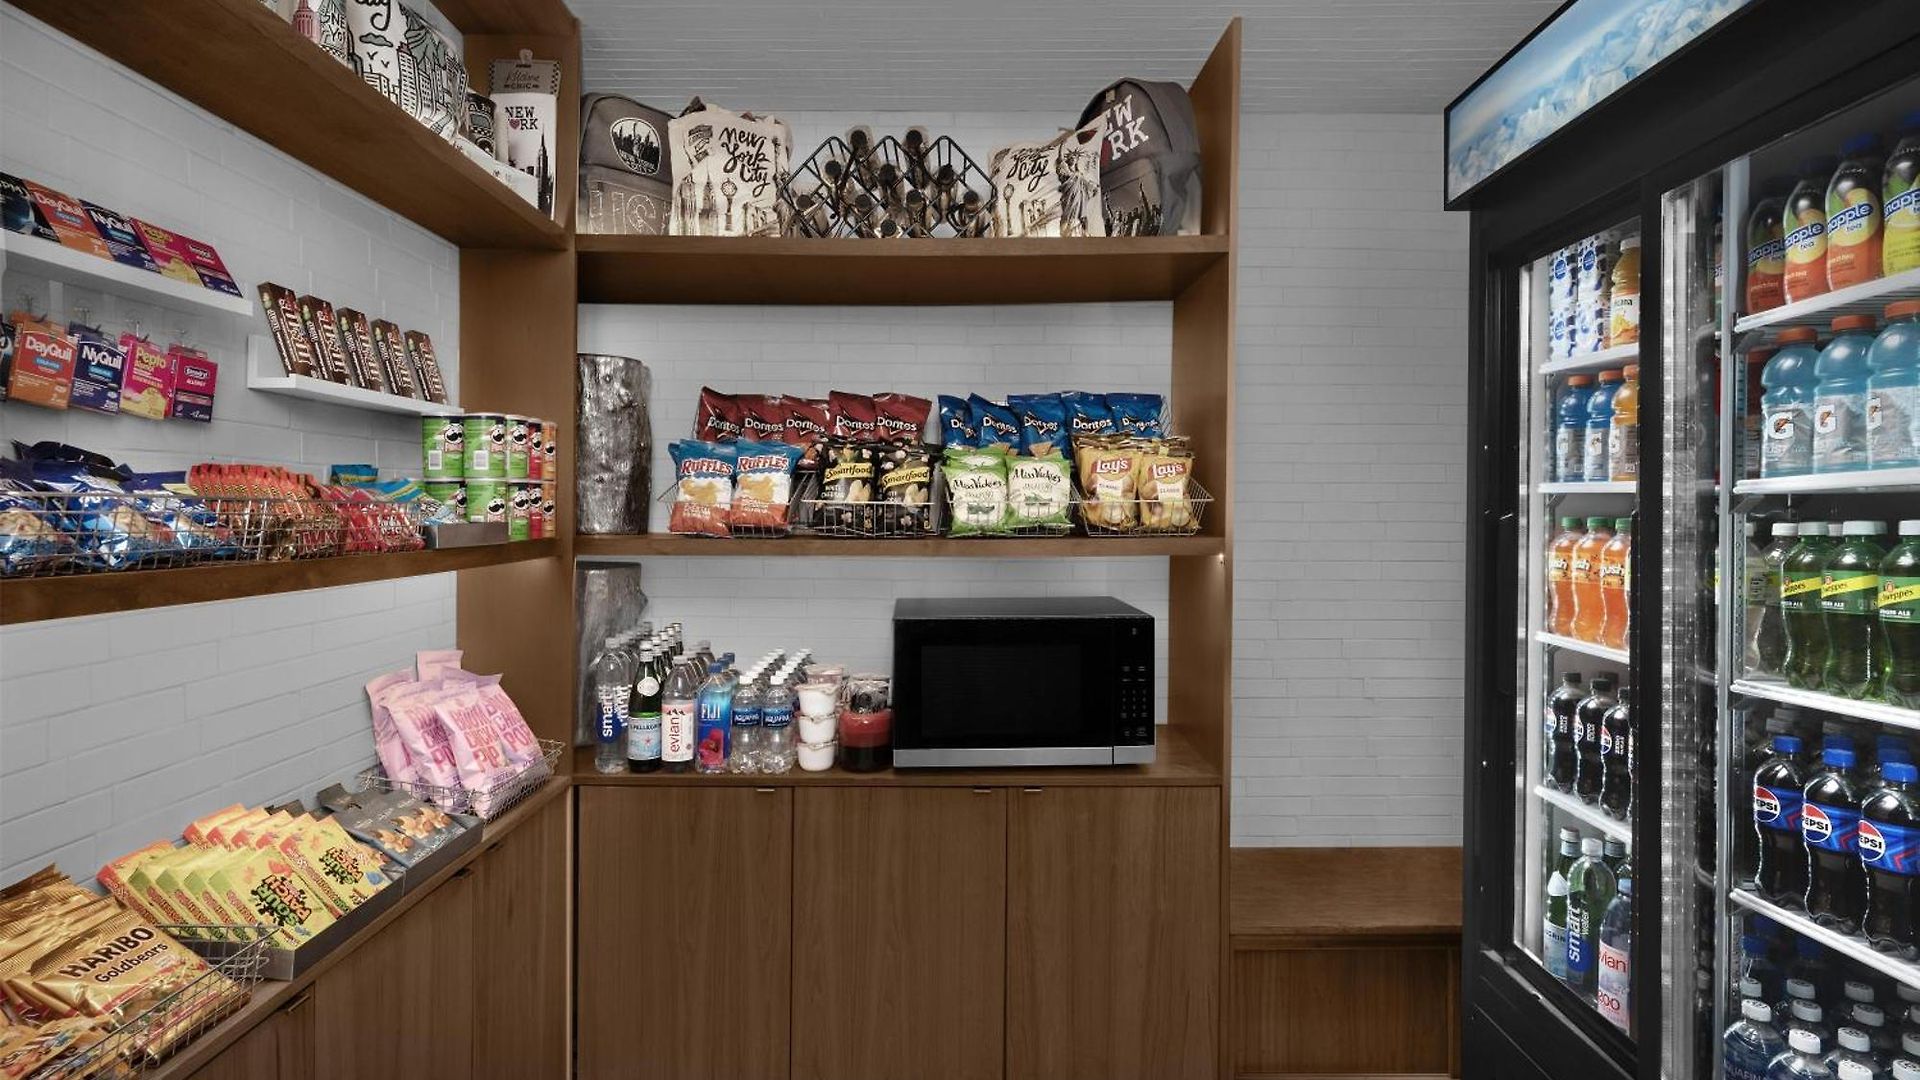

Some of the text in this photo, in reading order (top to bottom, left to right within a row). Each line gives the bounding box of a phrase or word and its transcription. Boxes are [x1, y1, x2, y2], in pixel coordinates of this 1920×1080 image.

[505, 106, 535, 118] NEW
[719, 127, 757, 147] New
[720, 137, 771, 173] York
[740, 163, 771, 198] City
[1018, 158, 1049, 192] City
[25, 336, 73, 362] DayQuil
[81, 345, 122, 370] NyQuil
[136, 346, 166, 369] Pepto
[708, 415, 740, 435] Doritos
[744, 417, 784, 432] Doritos
[786, 418, 826, 433] Doritos
[836, 415, 875, 430] Doritos
[877, 416, 918, 432] Doritos
[983, 416, 1018, 434] Doritos
[1024, 415, 1058, 434] Doritos
[1073, 418, 1112, 430] Doritos
[825, 464, 872, 479] Smartfood
[1096, 458, 1129, 473] Lay's
[1152, 464, 1184, 479] Lay's
[883, 470, 928, 486] Smartfood
[701, 703, 720, 720] FIJI
[669, 716, 681, 753] evian
[256, 883, 297, 927] SOUR
[1568, 903, 1582, 963] smart
[57, 925, 156, 979] HARIBO
[94, 942, 169, 984] Goldbears
